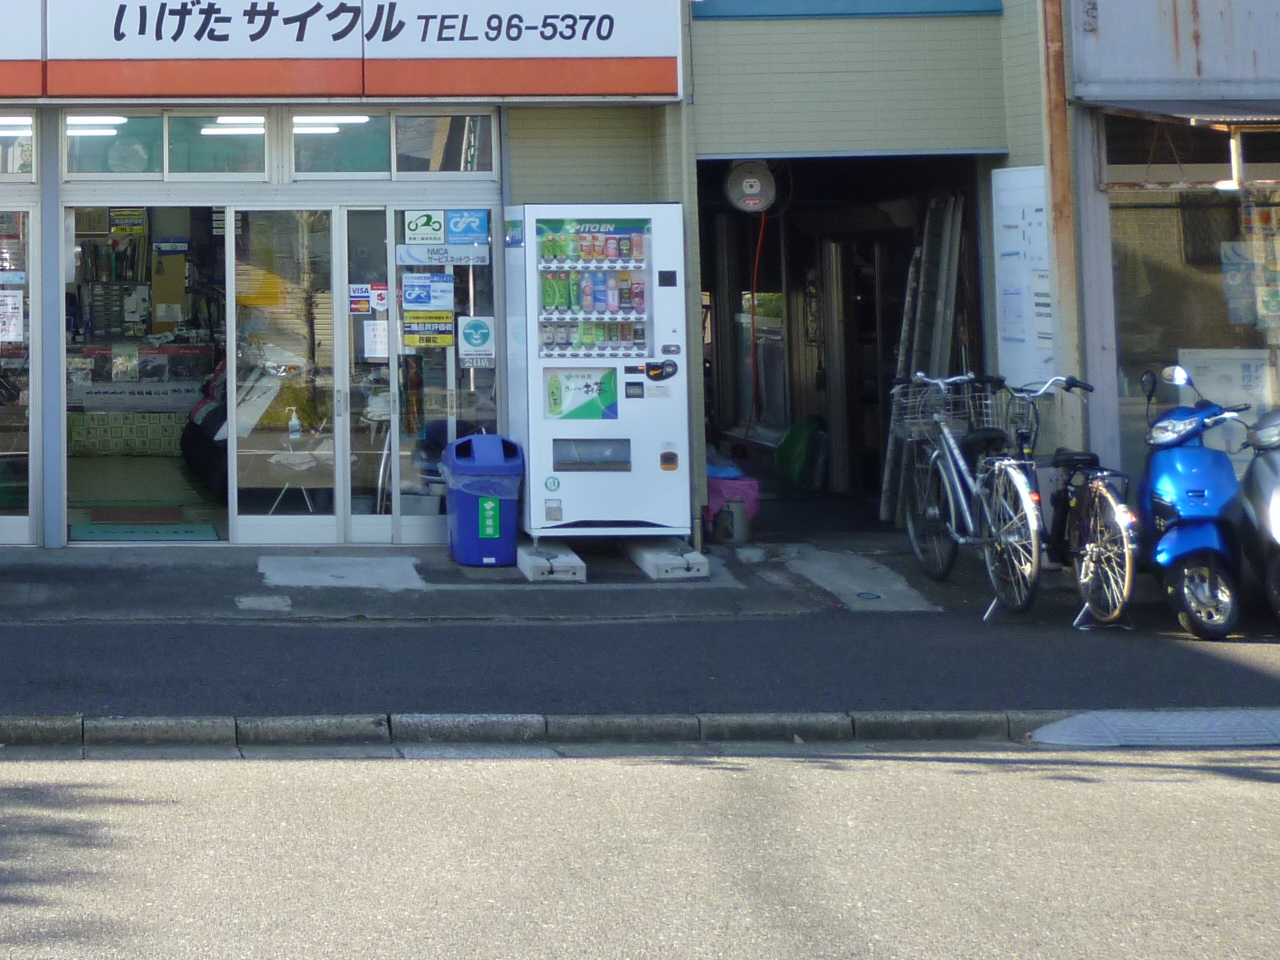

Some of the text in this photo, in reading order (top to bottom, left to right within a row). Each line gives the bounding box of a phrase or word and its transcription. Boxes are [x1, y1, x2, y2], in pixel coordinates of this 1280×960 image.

[113, 0, 615, 43] いげたサイクル TEL 96-5370
[580, 223, 615, 232] ITO EN
[427, 248, 449, 256] NMCA
